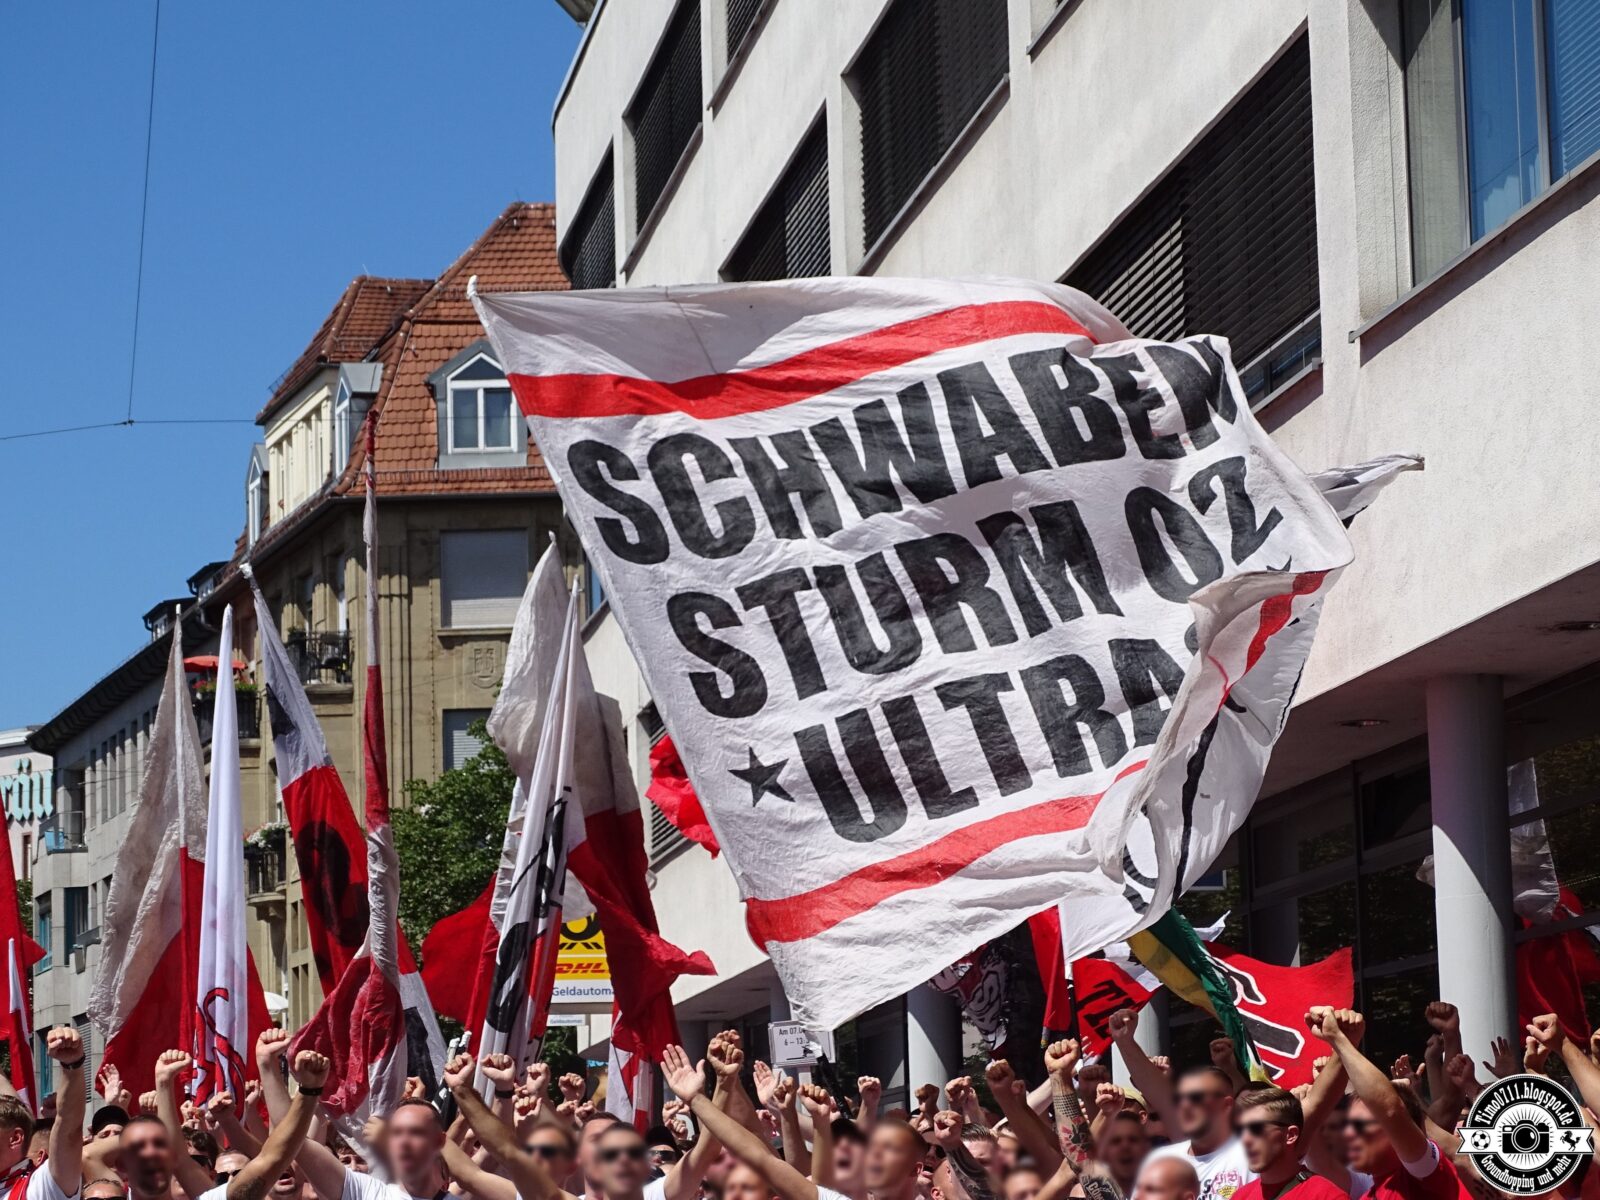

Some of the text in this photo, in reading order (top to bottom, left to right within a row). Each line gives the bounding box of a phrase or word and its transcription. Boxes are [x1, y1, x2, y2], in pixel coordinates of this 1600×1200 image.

[567, 336, 1238, 565] SCHWABEN
[667, 456, 1284, 718] STURM 02
[793, 622, 1201, 843] ULTRA
[552, 986, 615, 996] Geldautom
[555, 962, 609, 974] DHL
[779, 1028, 789, 1036] Am
